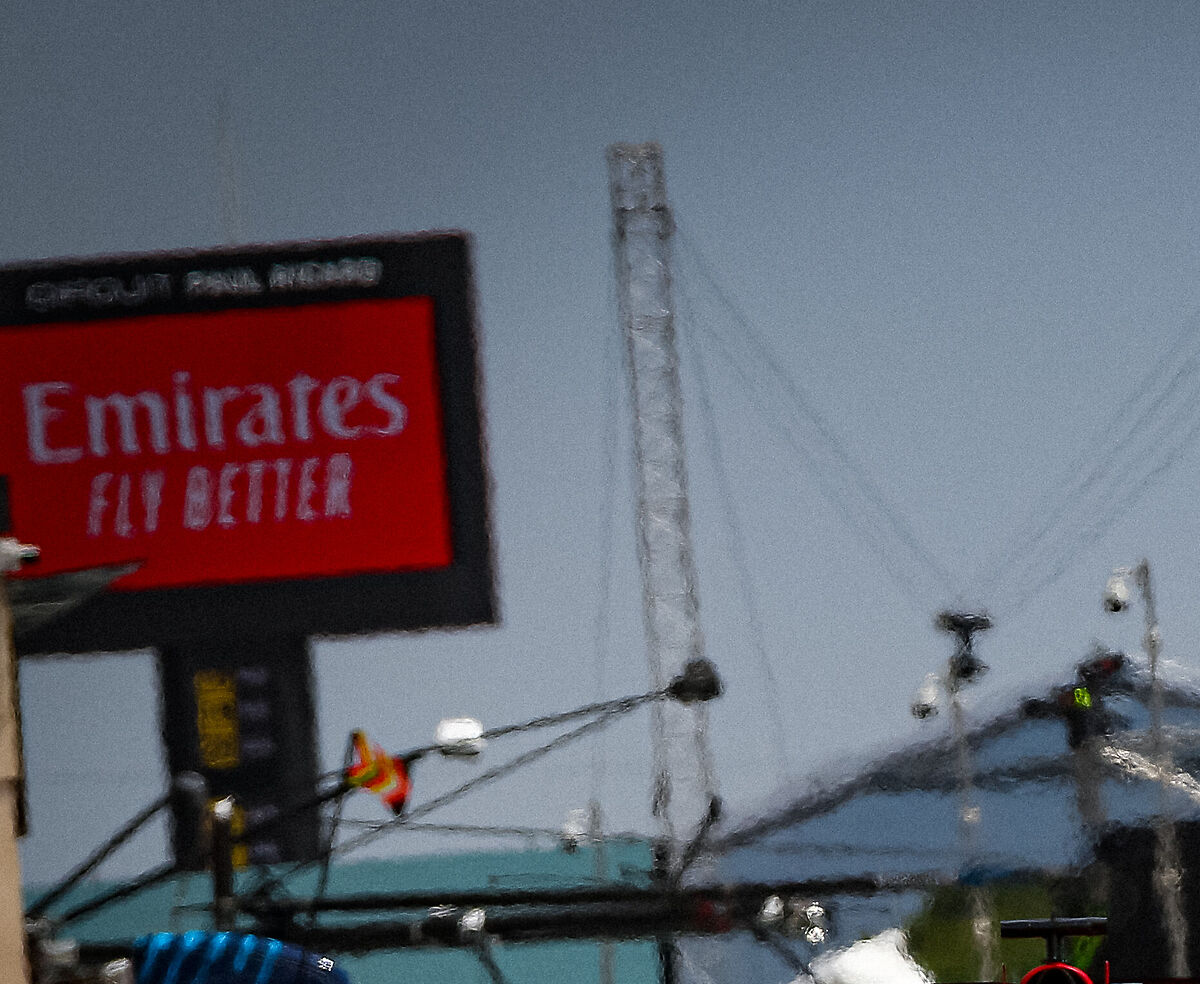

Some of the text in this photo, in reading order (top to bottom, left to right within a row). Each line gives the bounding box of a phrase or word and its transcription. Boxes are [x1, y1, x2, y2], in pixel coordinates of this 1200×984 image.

[21, 371, 408, 465] Emirates
[87, 453, 353, 537] FLY BETTER
